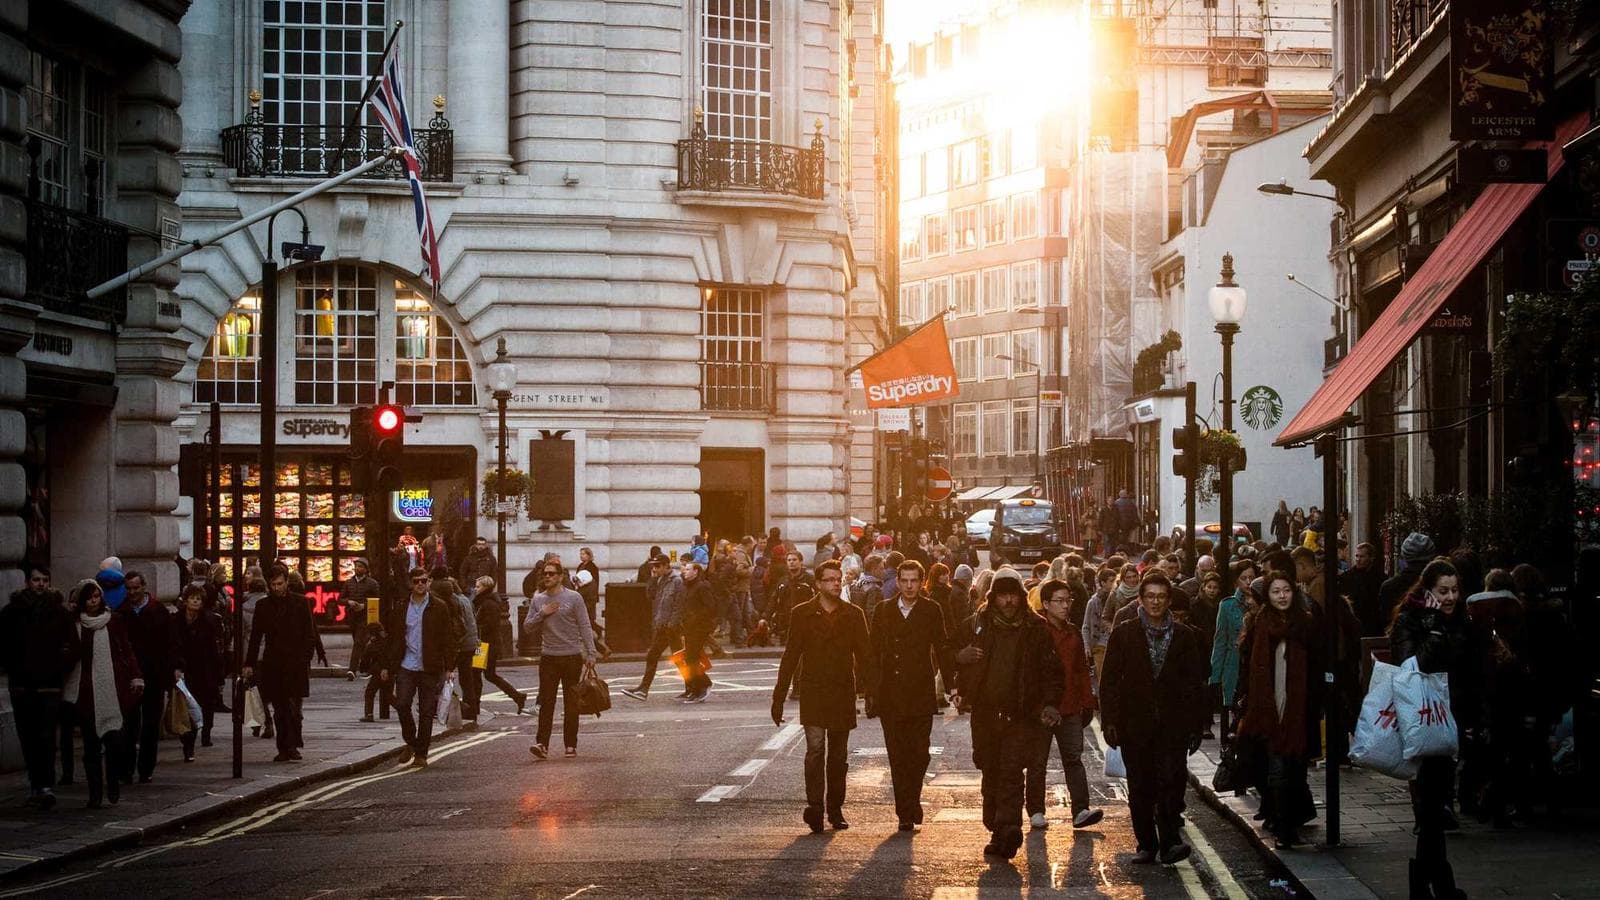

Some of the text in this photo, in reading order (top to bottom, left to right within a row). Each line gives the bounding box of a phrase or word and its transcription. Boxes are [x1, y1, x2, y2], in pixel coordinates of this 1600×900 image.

[1471, 116, 1537, 126] LEICESTER
[1487, 127, 1521, 137] ARMS
[868, 374, 952, 403] Superdry
[506, 395, 540, 403] GENT
[548, 395, 585, 403] STREET
[283, 419, 351, 439] Superdry
[399, 489, 430, 500] T-SHIRT
[401, 498, 434, 508] GALLERY
